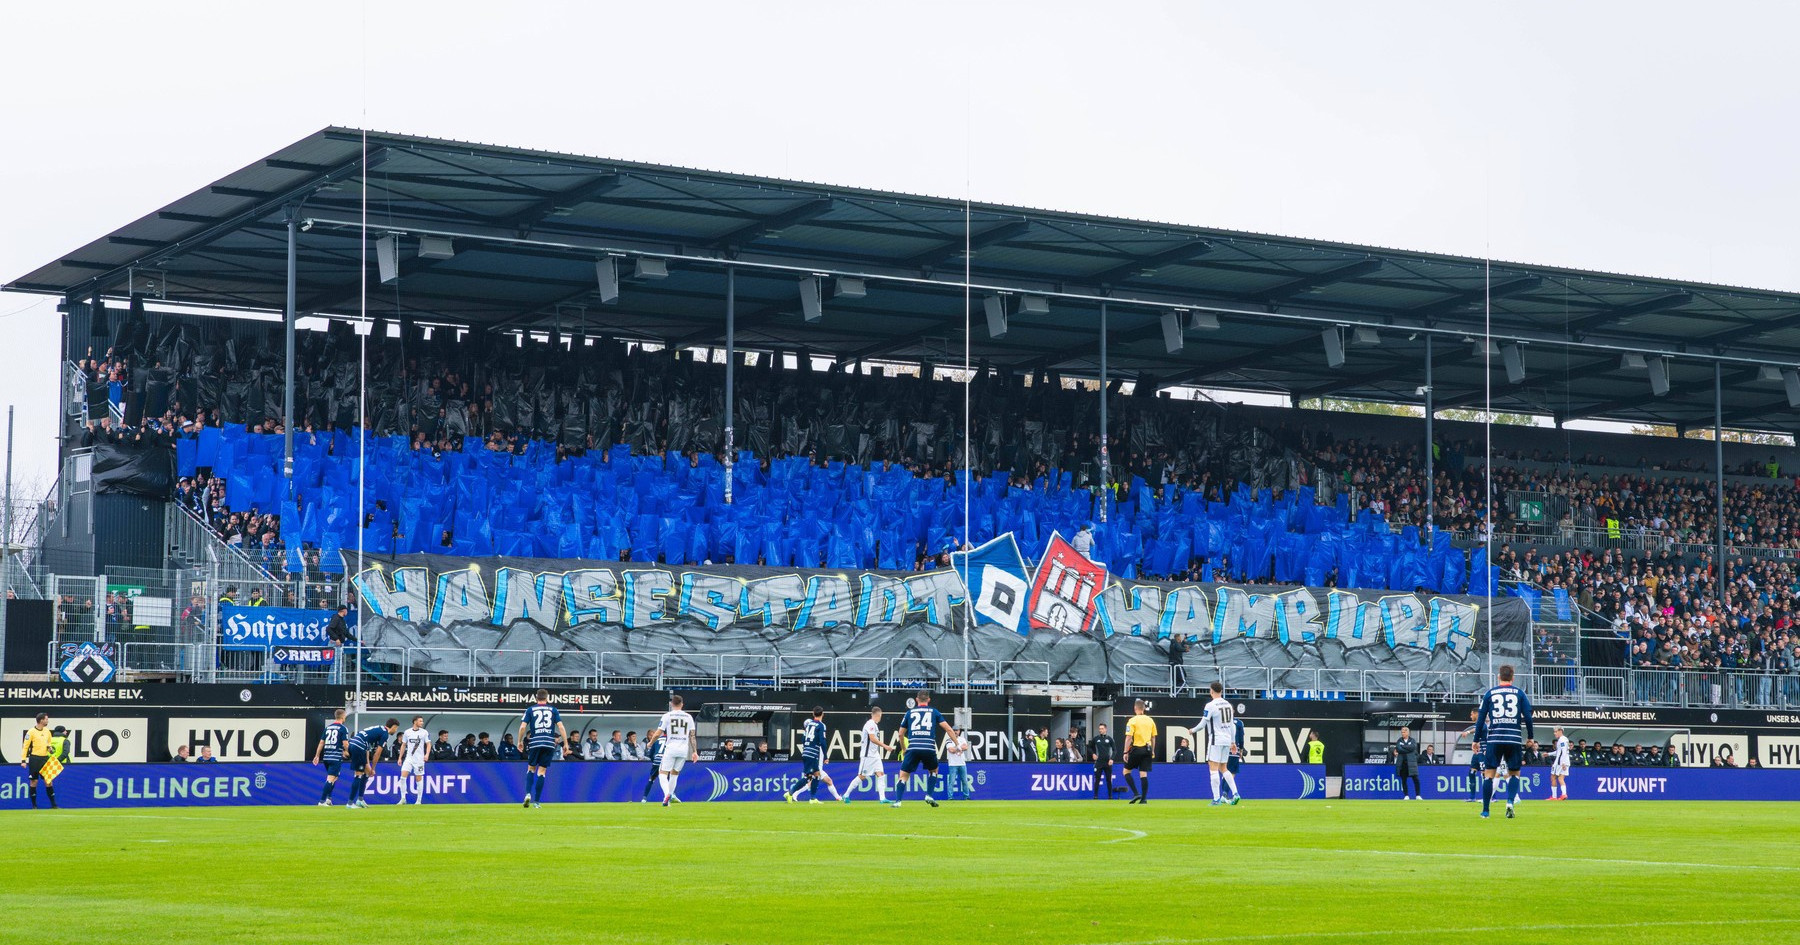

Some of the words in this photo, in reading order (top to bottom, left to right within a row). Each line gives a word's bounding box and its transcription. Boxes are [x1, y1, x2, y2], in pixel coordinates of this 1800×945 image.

[351, 563, 966, 632] HANSESTADT
[1093, 582, 1479, 659] HAMBURG
[288, 649, 321, 661] RNR
[8, 688, 61, 698] HEIMAT.
[64, 688, 115, 698] UNSERE
[118, 689, 143, 699] ELV.
[345, 691, 383, 701] UNSER
[386, 692, 451, 702] SAARLAND.
[454, 693, 498, 703] UNSERE
[502, 694, 538, 704] HEIMA
[547, 694, 589, 704] UNSERE
[591, 695, 612, 705] ELV.
[1491, 694, 1518, 718] 33
[533, 710, 552, 728] 23
[911, 712, 932, 730] 24
[1219, 707, 1232, 723] 10
[1551, 711, 1580, 719] UNSERE
[1581, 711, 1611, 719] HEIMAT.
[1612, 712, 1641, 720] UNSERE
[1642, 712, 1656, 720] ELV.
[1767, 715, 1789, 723] UNSER
[671, 719, 688, 735] 24
[806, 725, 816, 741] 14
[325, 730, 339, 744] 28
[94, 777, 251, 799] DILLINGER
[364, 775, 471, 795] ZUKUNFT
[1597, 777, 1667, 793] ZUKUNFT
